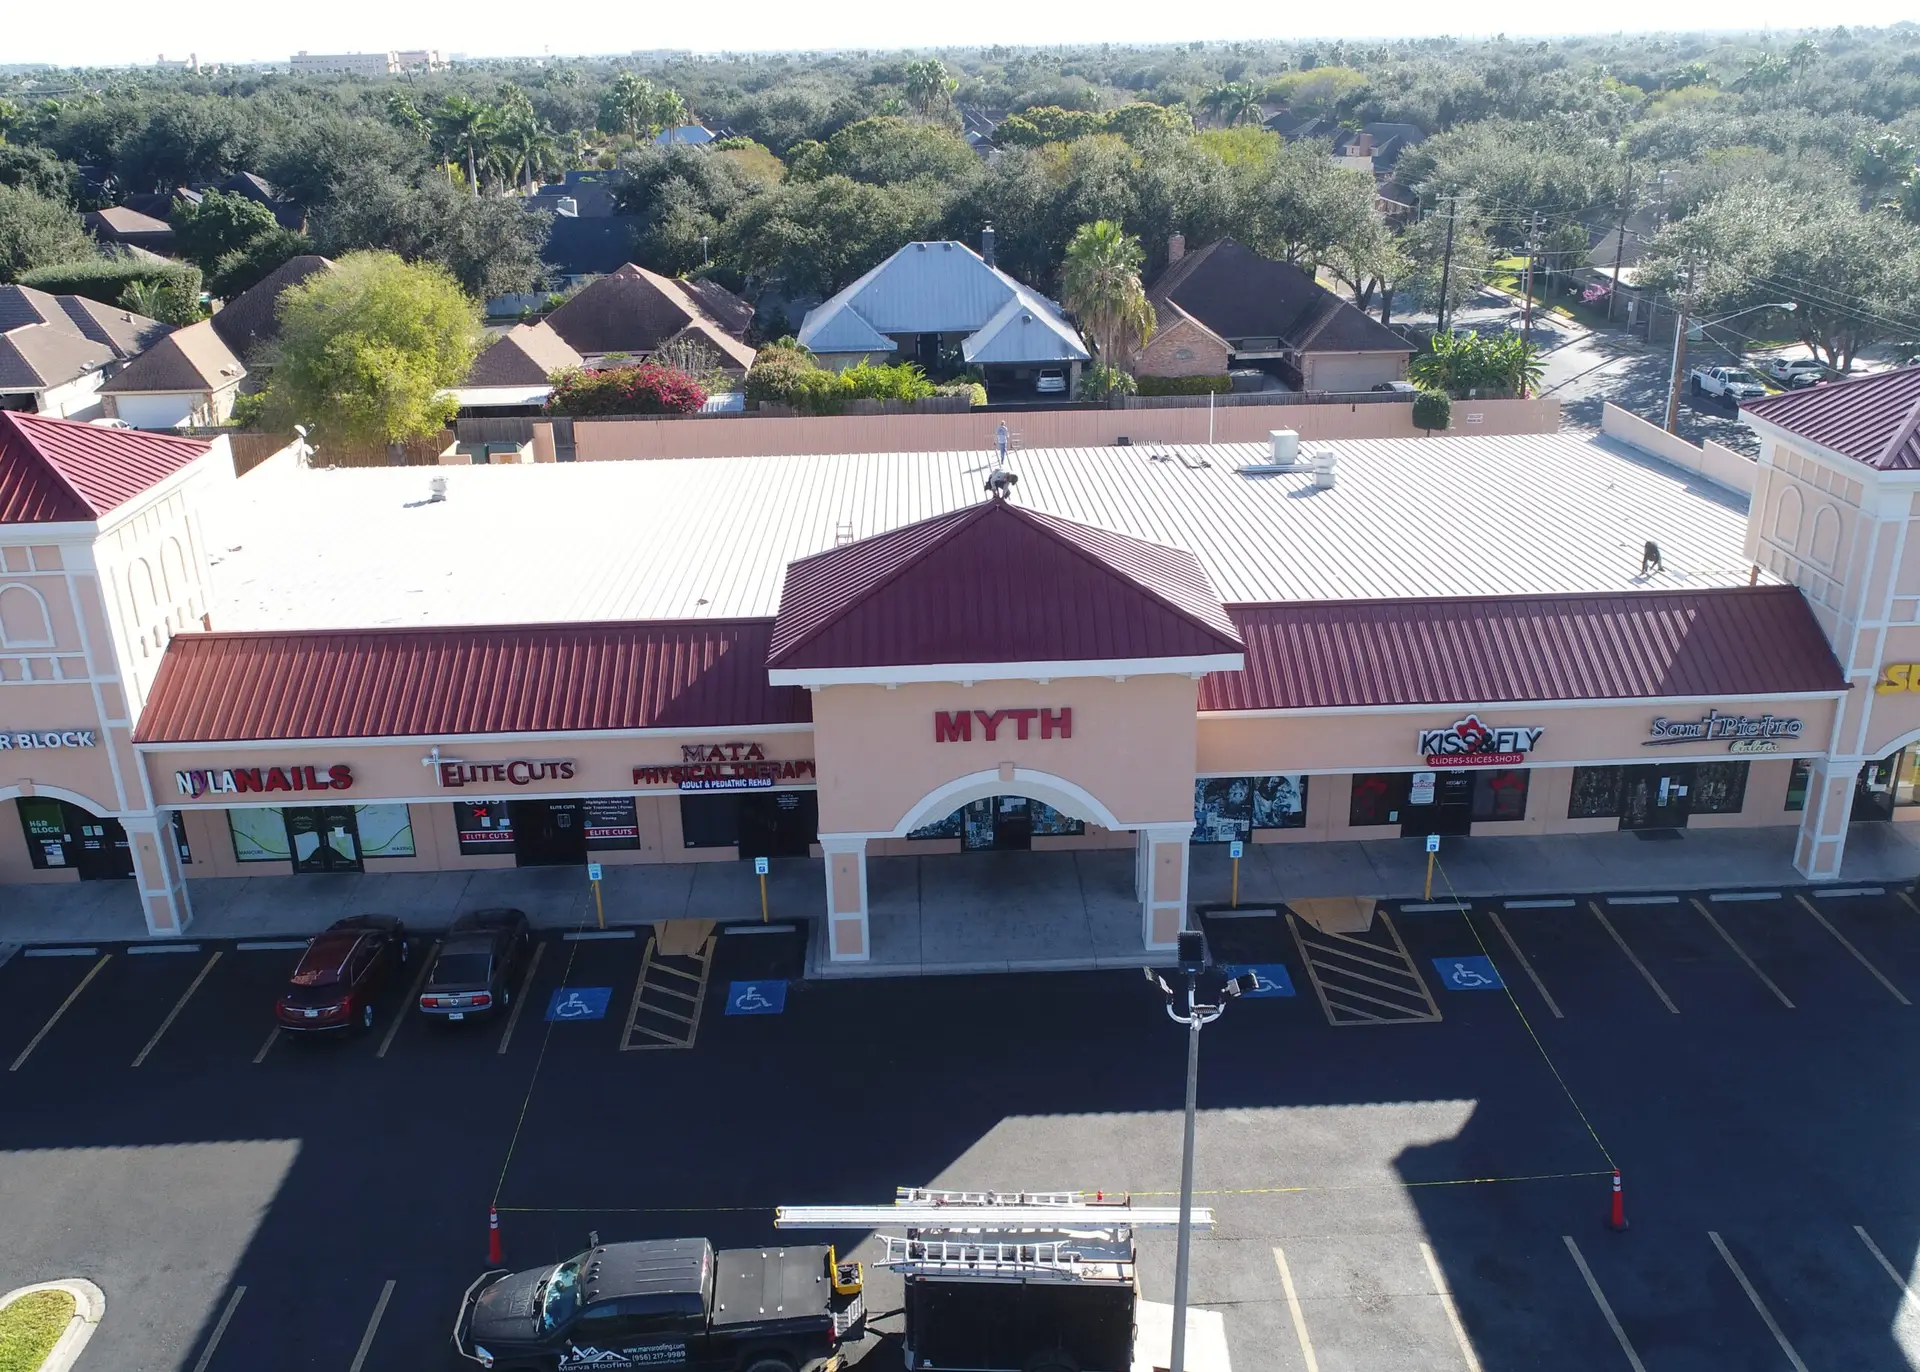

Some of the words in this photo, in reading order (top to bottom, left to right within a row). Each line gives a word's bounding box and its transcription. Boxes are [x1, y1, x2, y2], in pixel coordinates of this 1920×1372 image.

[935, 708, 1071, 742] MYTH
[1653, 717, 1701, 737] San
[1719, 714, 1803, 738] Pietro
[17, 731, 95, 749] BLOCK
[681, 742, 765, 763] MATA
[632, 763, 728, 785] PHYSICAL
[729, 761, 816, 780] THERAPY
[681, 779, 703, 789] ADULT
[711, 778, 747, 788] PEDIATRIC
[749, 777, 772, 787] REHAB
[31, 826, 61, 834] BLOCK
[465, 832, 487, 840] ELITE
[488, 831, 510, 840] CUTS
[632, 1353, 651, 1362] (956)
[558, 1364, 590, 1372] Marva
[592, 1360, 633, 1370] Roofing
